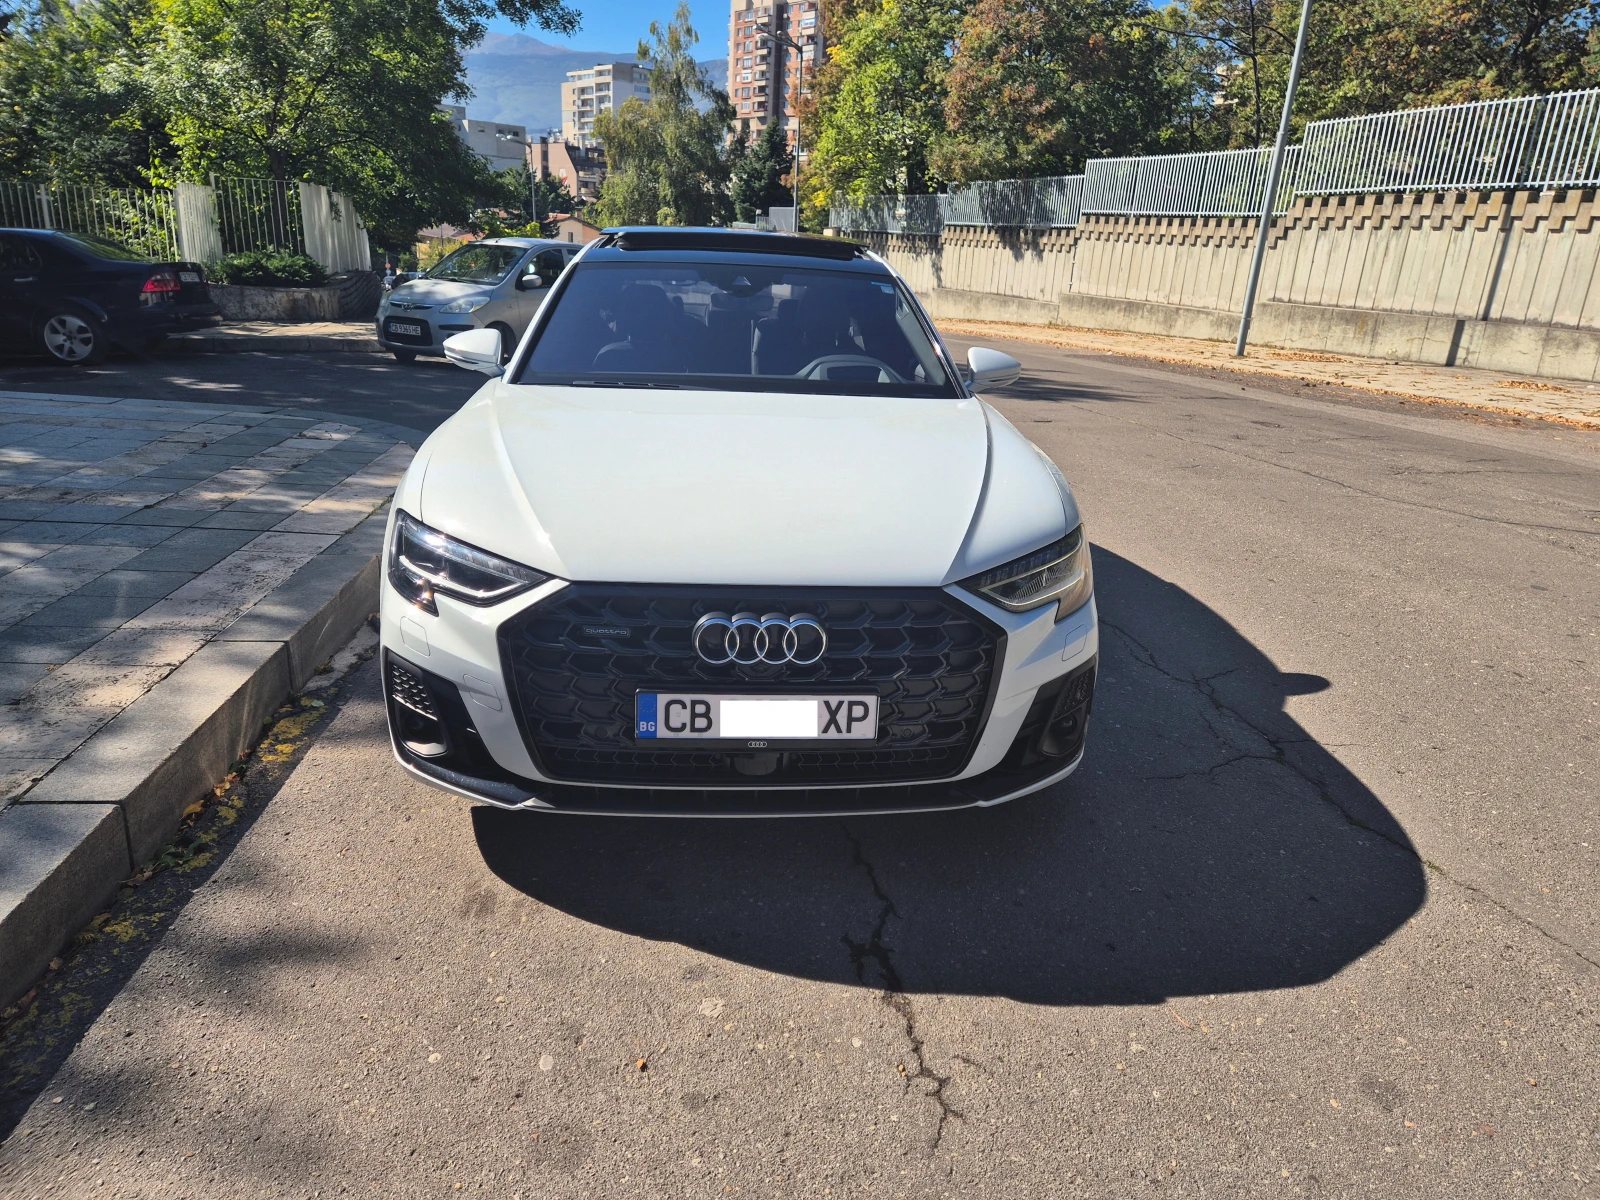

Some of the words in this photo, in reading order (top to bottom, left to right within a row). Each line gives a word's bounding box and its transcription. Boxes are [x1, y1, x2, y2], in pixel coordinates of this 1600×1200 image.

[639, 721, 656, 732] BG
[664, 699, 713, 733] CB
[821, 700, 870, 734] XP
